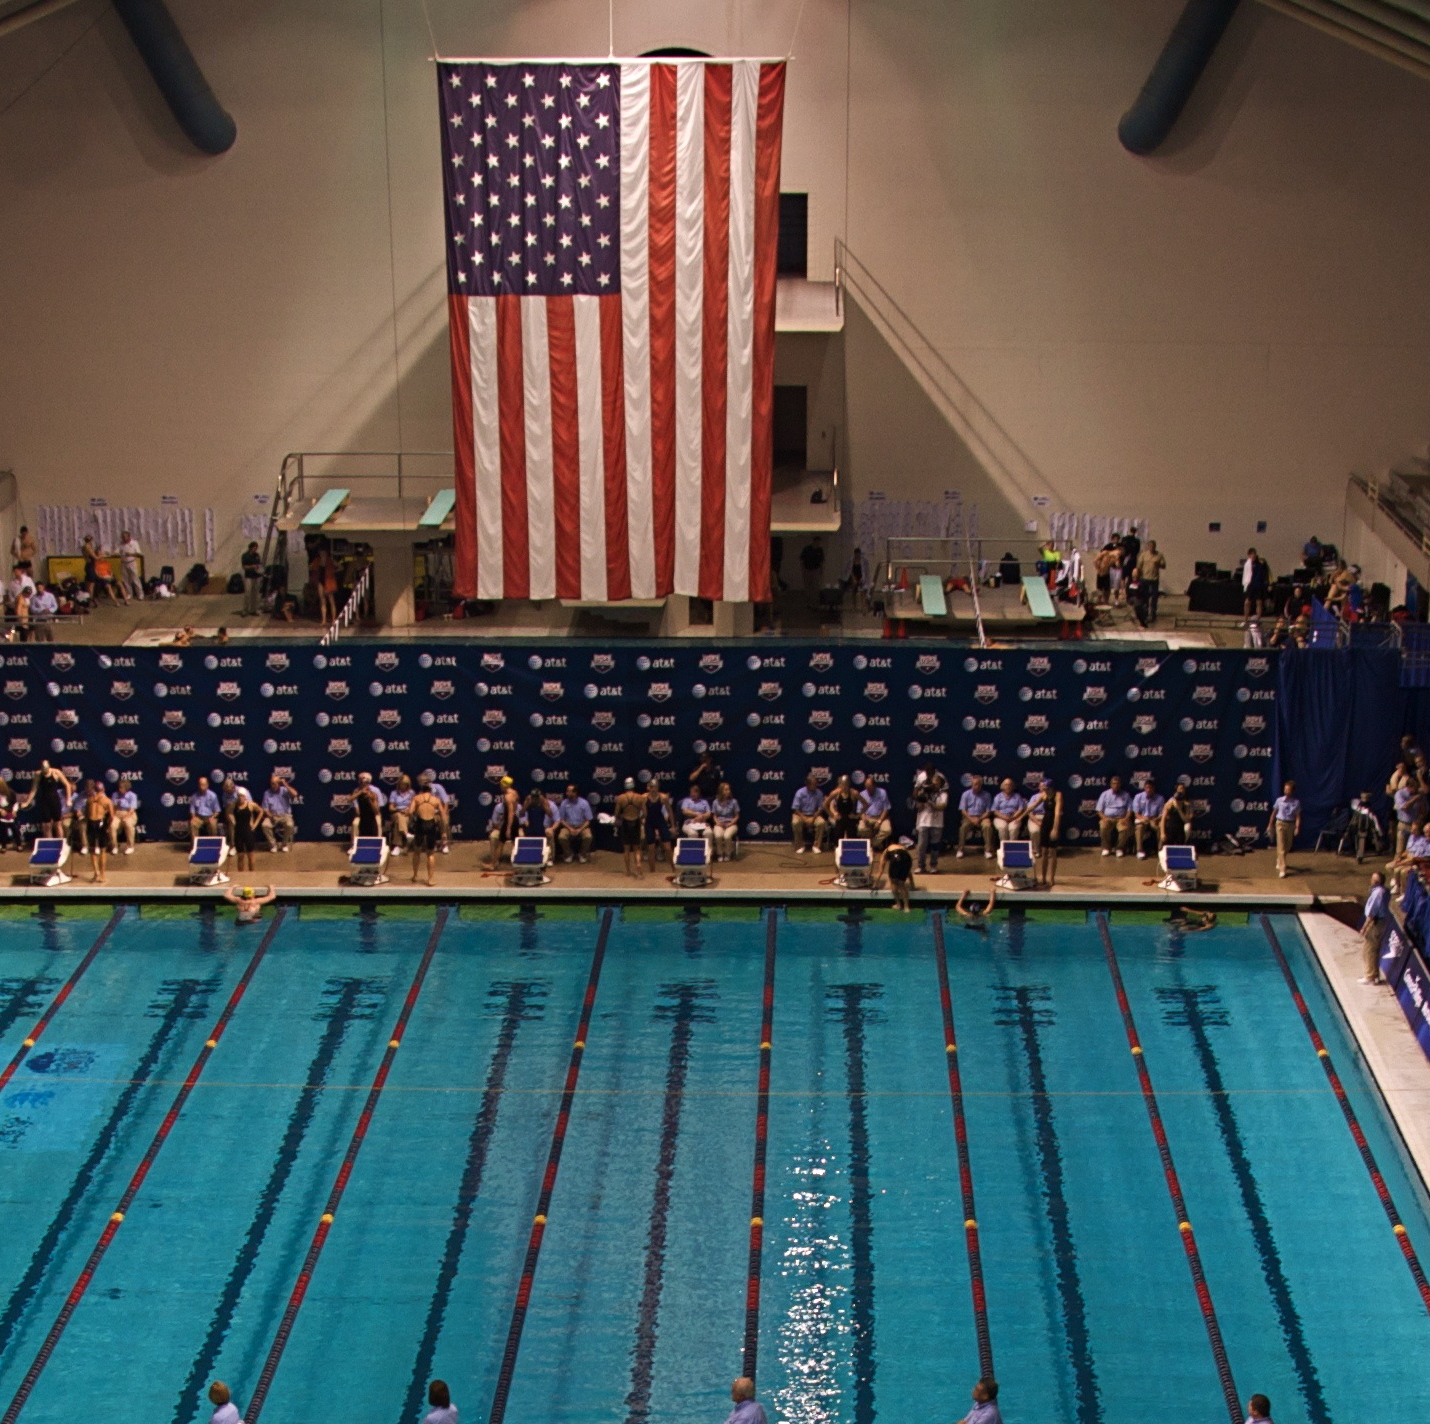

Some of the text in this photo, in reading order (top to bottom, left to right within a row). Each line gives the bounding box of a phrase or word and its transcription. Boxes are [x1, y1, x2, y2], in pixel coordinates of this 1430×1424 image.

[5, 655, 29, 666] at&t
[113, 656, 136, 667] at&t
[219, 656, 243, 668] at&t
[328, 656, 352, 667] at&t
[434, 656, 457, 667] at&t
[544, 657, 567, 668] at&t
[652, 657, 675, 668] at&t
[762, 657, 786, 668] at&t
[869, 657, 892, 668] at&t
[979, 659, 1003, 670] at&t
[1198, 660, 1222, 672] at&t
[1088, 661, 1111, 672] at&t
[61, 683, 84, 695] at&t
[169, 684, 192, 696] at&t
[275, 684, 298, 695] at&t
[384, 683, 408, 694] at&t
[489, 684, 513, 695] at&t
[599, 685, 623, 697] at&t
[707, 685, 731, 696] at&t
[817, 684, 841, 695] at&t
[923, 686, 947, 698] at&t
[1034, 688, 1058, 700] at&t
[1142, 689, 1166, 700] at&t
[1251, 689, 1276, 701] at&t
[10, 713, 33, 724] at&t
[116, 714, 140, 725] at&t
[222, 714, 246, 725] at&t
[331, 714, 354, 725] at&t
[436, 713, 459, 724] at&t
[545, 715, 568, 726] at&t
[652, 715, 676, 726] at&t
[762, 714, 785, 725] at&t
[867, 715, 891, 726] at&t
[977, 718, 1001, 729] at&t
[1086, 719, 1109, 731] at&t
[1195, 719, 1218, 730] at&t
[66, 740, 88, 751] at&t
[172, 740, 196, 752] at&t
[278, 740, 302, 751] at&t
[387, 740, 410, 751] at&t
[492, 740, 515, 751] at&t
[601, 742, 624, 752] at&t
[708, 741, 731, 752] at&t
[817, 741, 840, 752] at&t
[922, 743, 946, 754] at&t
[1140, 745, 1163, 756] at&t
[1032, 746, 1056, 757] at&t
[1249, 746, 1273, 758] at&t
